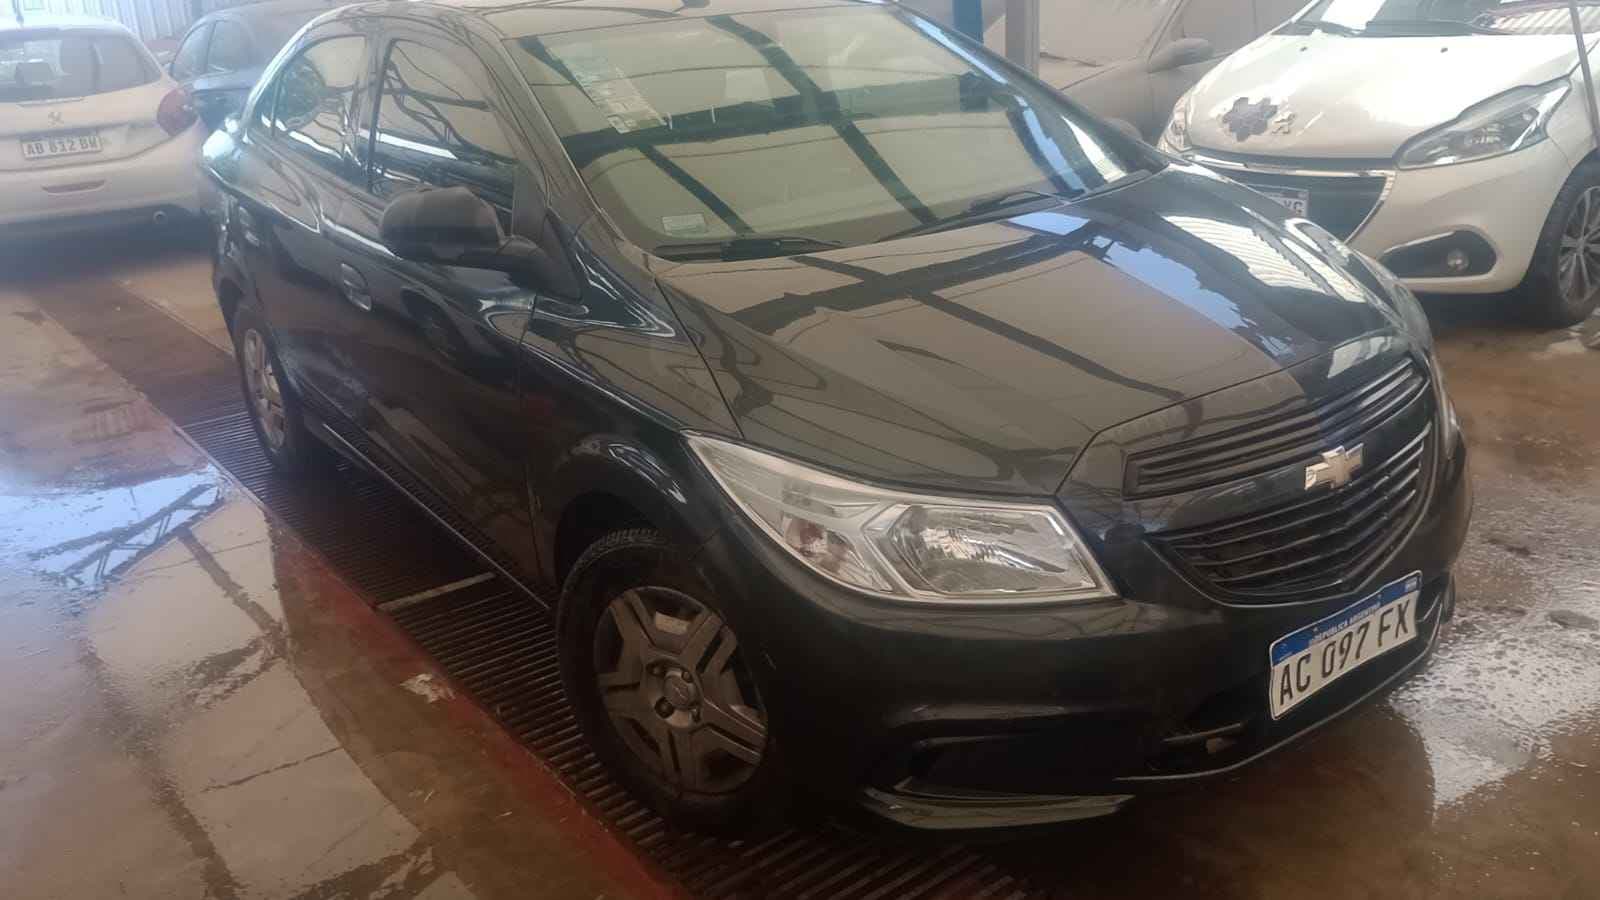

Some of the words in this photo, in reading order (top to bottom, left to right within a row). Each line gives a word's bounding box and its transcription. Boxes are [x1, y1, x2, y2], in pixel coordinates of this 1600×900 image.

[1280, 653, 1312, 706] AC
[1321, 621, 1371, 678] 097
[1377, 598, 1410, 647] FX
